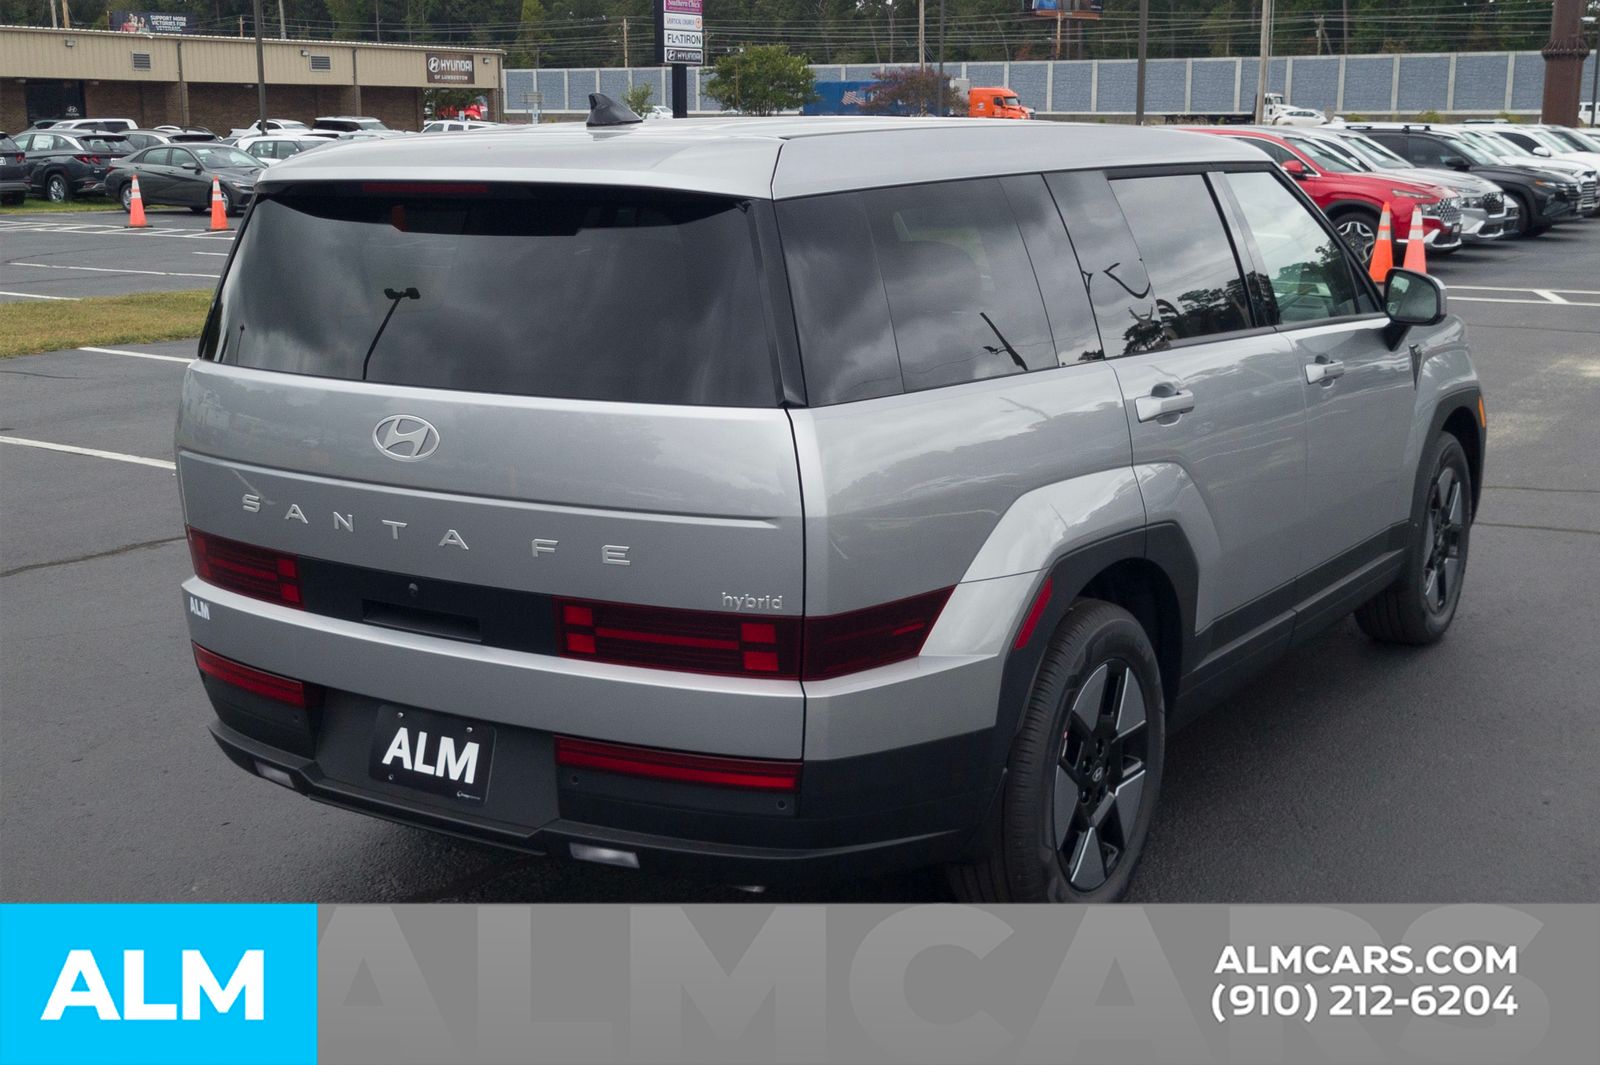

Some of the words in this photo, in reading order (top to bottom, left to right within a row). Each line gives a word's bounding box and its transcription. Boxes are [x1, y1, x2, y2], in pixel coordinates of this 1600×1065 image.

[667, 33, 701, 44] FLATIRON
[440, 59, 472, 72] HYUNDAI
[241, 493, 469, 551] SANTA
[531, 538, 632, 566] FE
[190, 596, 210, 620] ALM
[721, 591, 784, 611] hybrid
[381, 726, 480, 785] ALM
